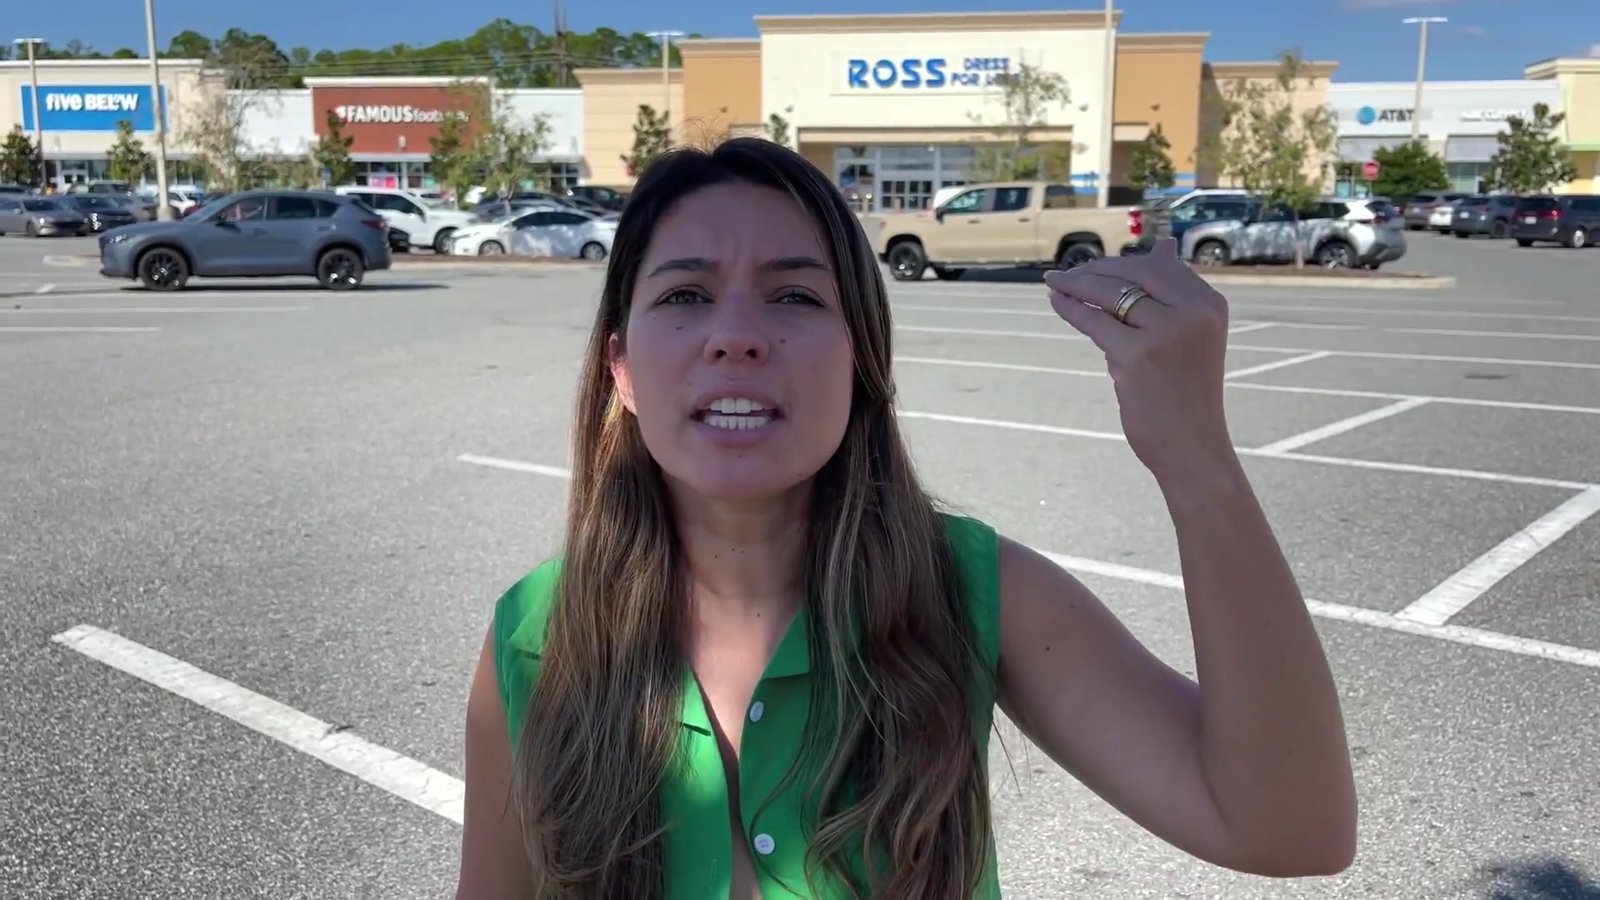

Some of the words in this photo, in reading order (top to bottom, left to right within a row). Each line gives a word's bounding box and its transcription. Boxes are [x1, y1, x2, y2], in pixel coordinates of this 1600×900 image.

[963, 57, 1009, 71] DRESS
[848, 59, 946, 88] ROSS
[951, 73, 979, 86] FOR
[46, 93, 82, 111] five
[347, 105, 413, 123] FAMOUS
[1379, 108, 1415, 122] AT&T
